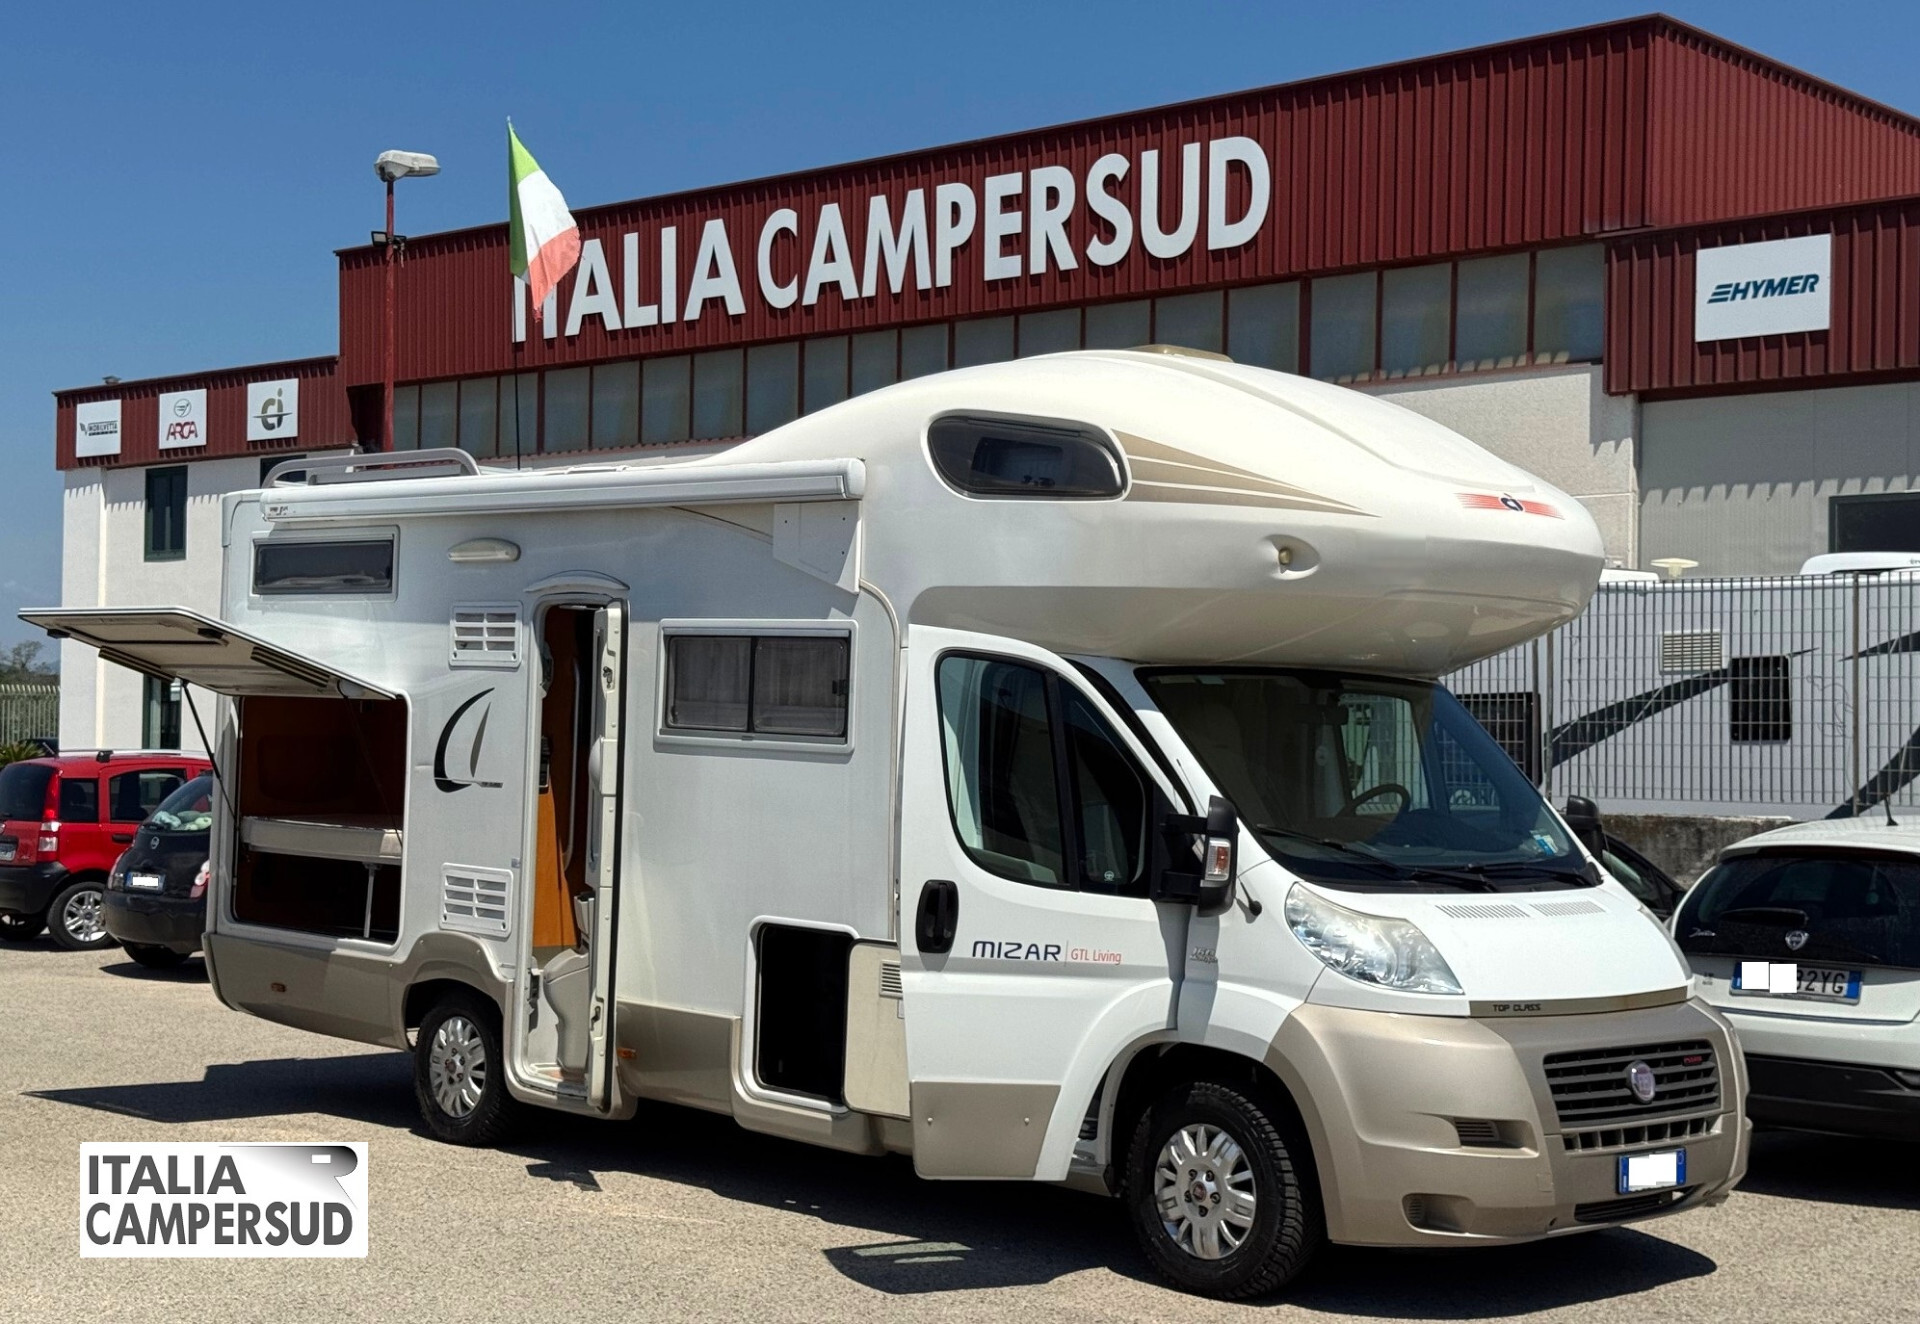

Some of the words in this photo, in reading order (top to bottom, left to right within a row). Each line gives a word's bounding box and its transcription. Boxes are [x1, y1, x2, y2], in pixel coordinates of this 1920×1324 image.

[757, 136, 1270, 309] CAMPERSUD
[1729, 273, 1820, 302] HYMER
[166, 421, 198, 441] ARCA
[972, 940, 1062, 962] MIZAR
[1071, 947, 1090, 961] GTL
[1092, 949, 1122, 966] Living
[1493, 1003, 1510, 1012] TOP
[1513, 1003, 1542, 1011] CLASS
